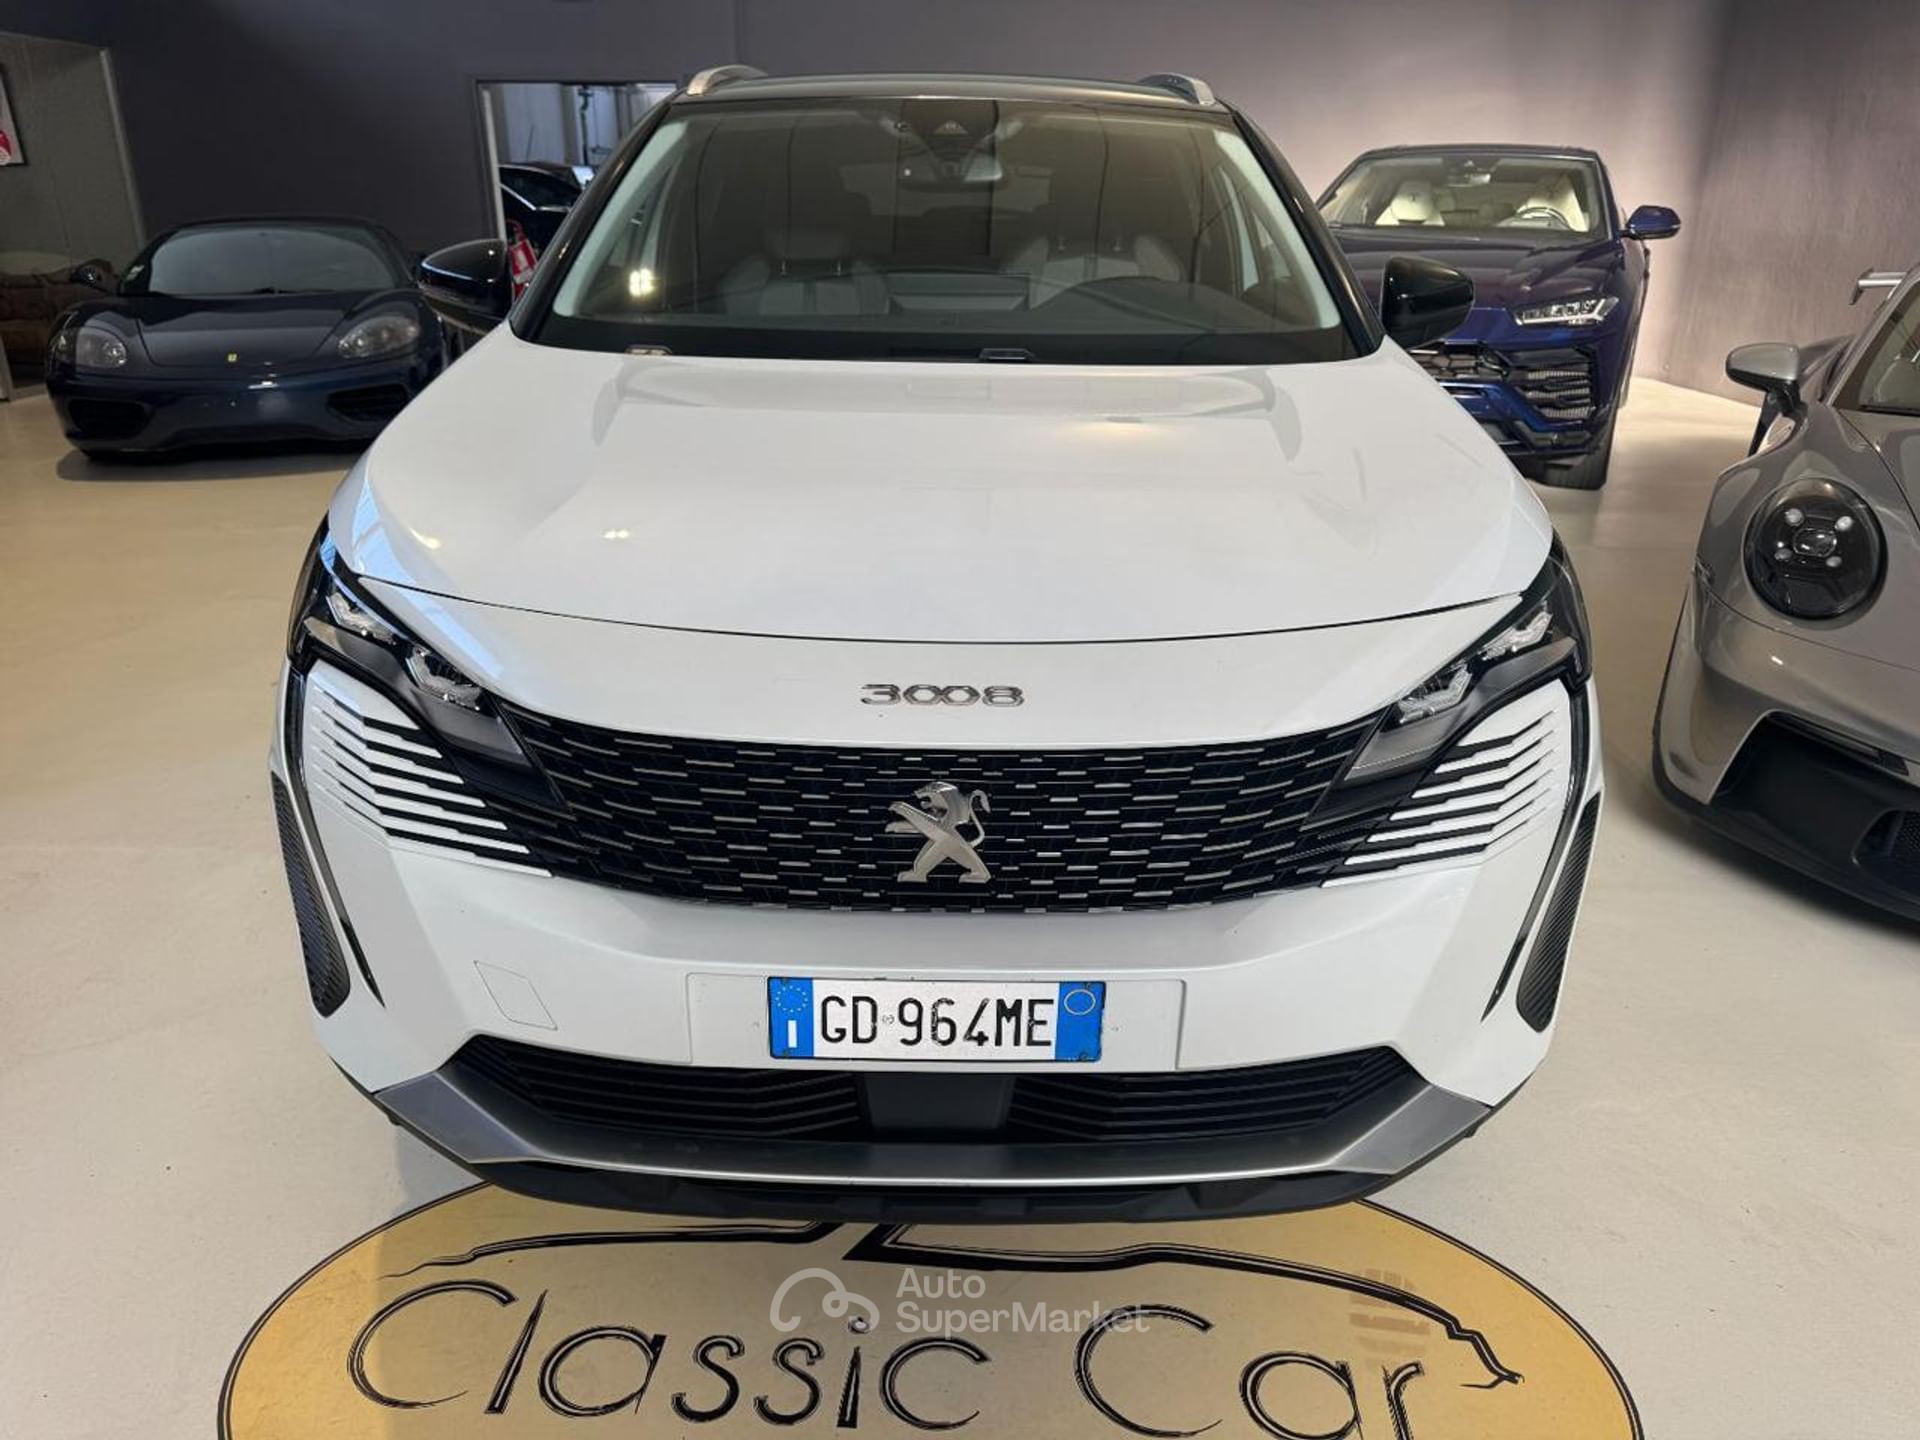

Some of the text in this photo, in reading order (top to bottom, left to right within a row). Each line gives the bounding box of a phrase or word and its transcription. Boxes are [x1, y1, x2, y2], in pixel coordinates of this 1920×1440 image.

[860, 684, 1025, 706] 3008
[347, 1279, 1424, 1440] Classic Car
